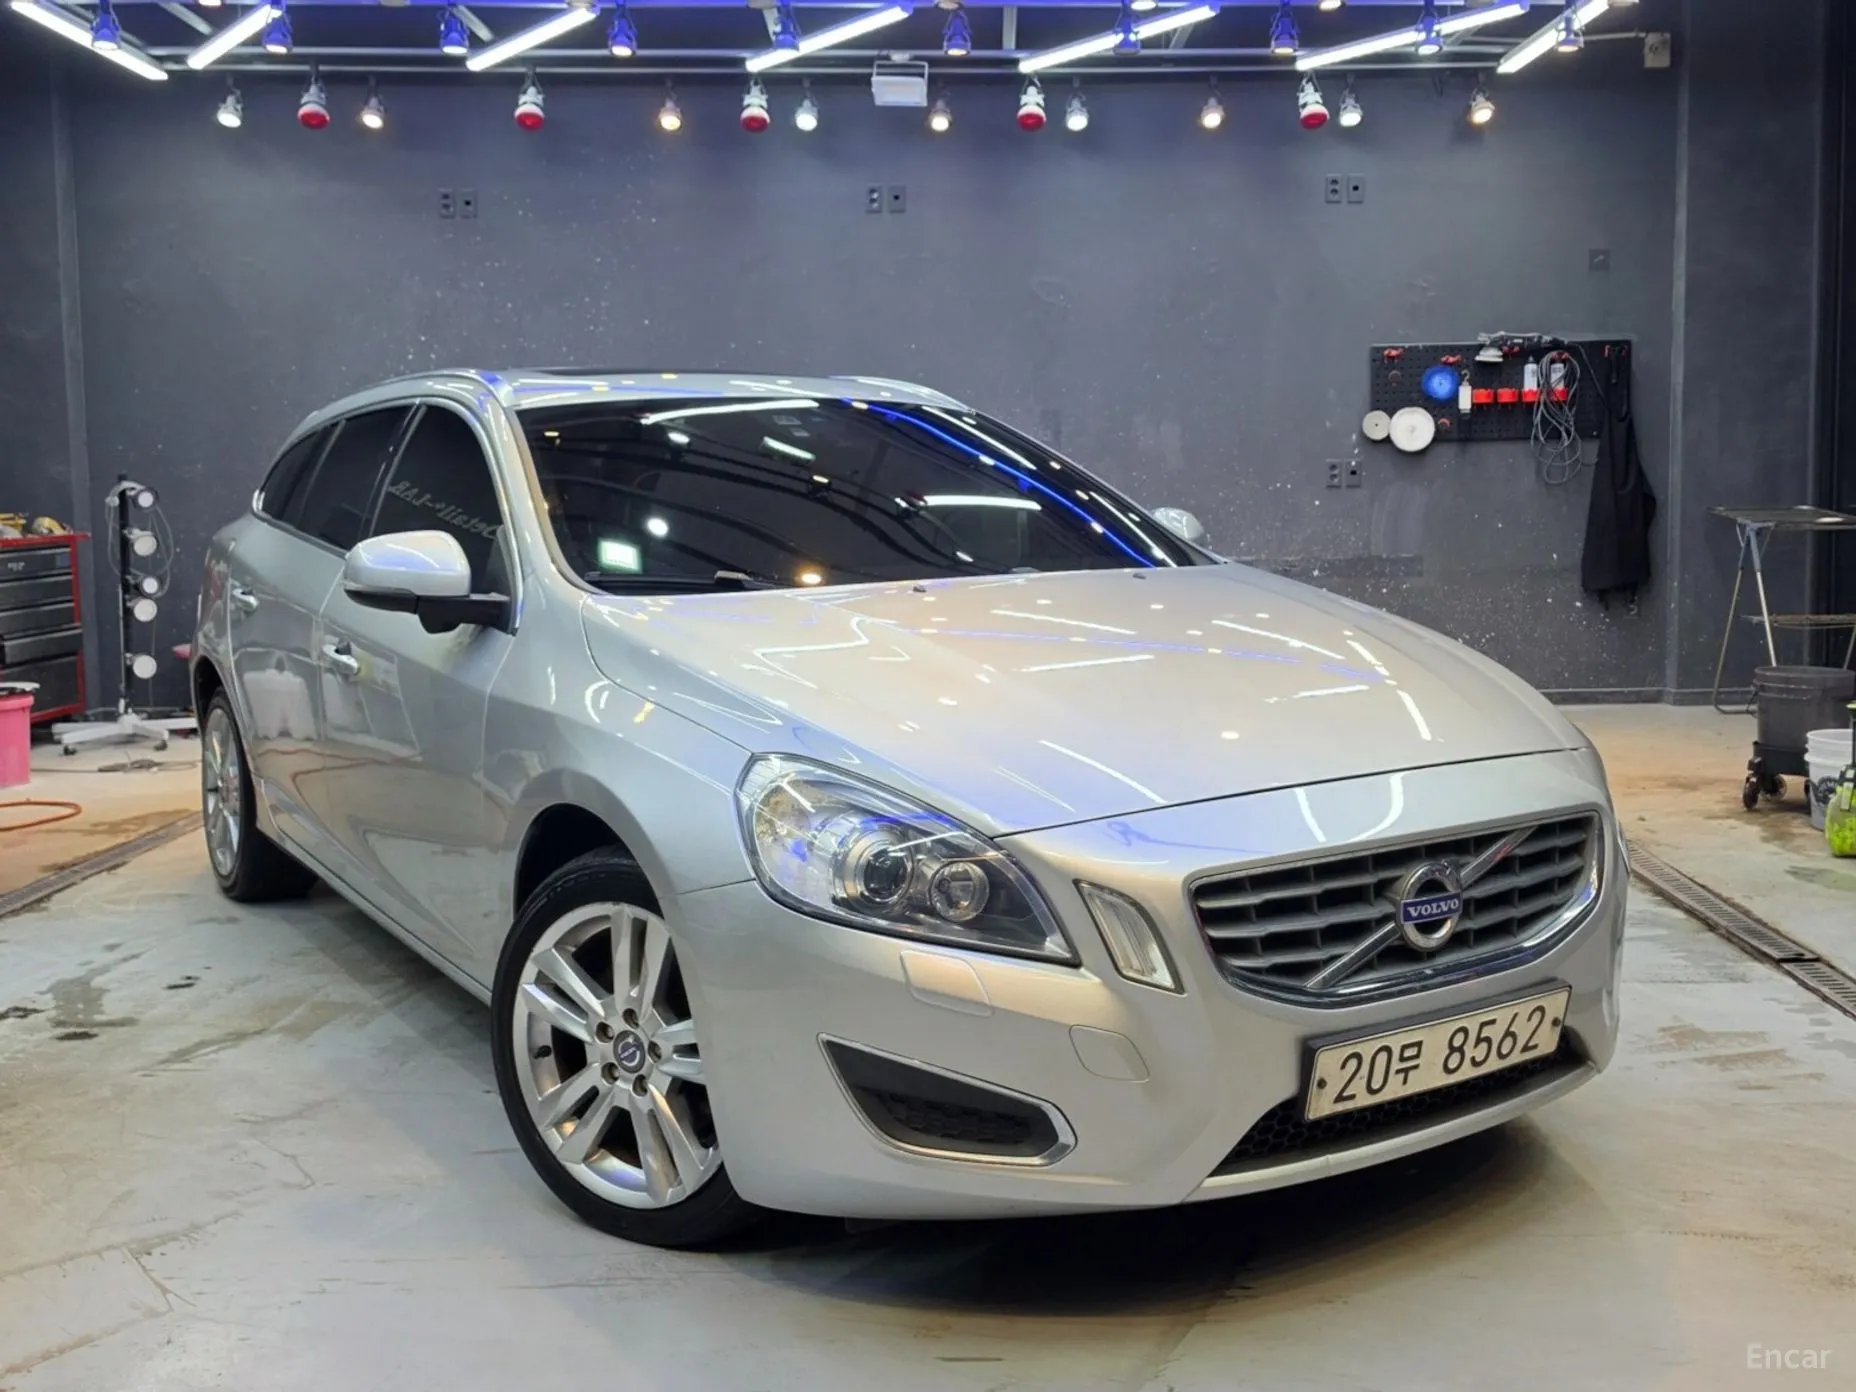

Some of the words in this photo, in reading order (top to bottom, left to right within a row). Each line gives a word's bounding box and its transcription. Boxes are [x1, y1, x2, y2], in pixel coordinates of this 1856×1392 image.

[1407, 898, 1459, 917] VOLVO
[1333, 1040, 1423, 1104] 20무
[1442, 1005, 1546, 1075] 8562
